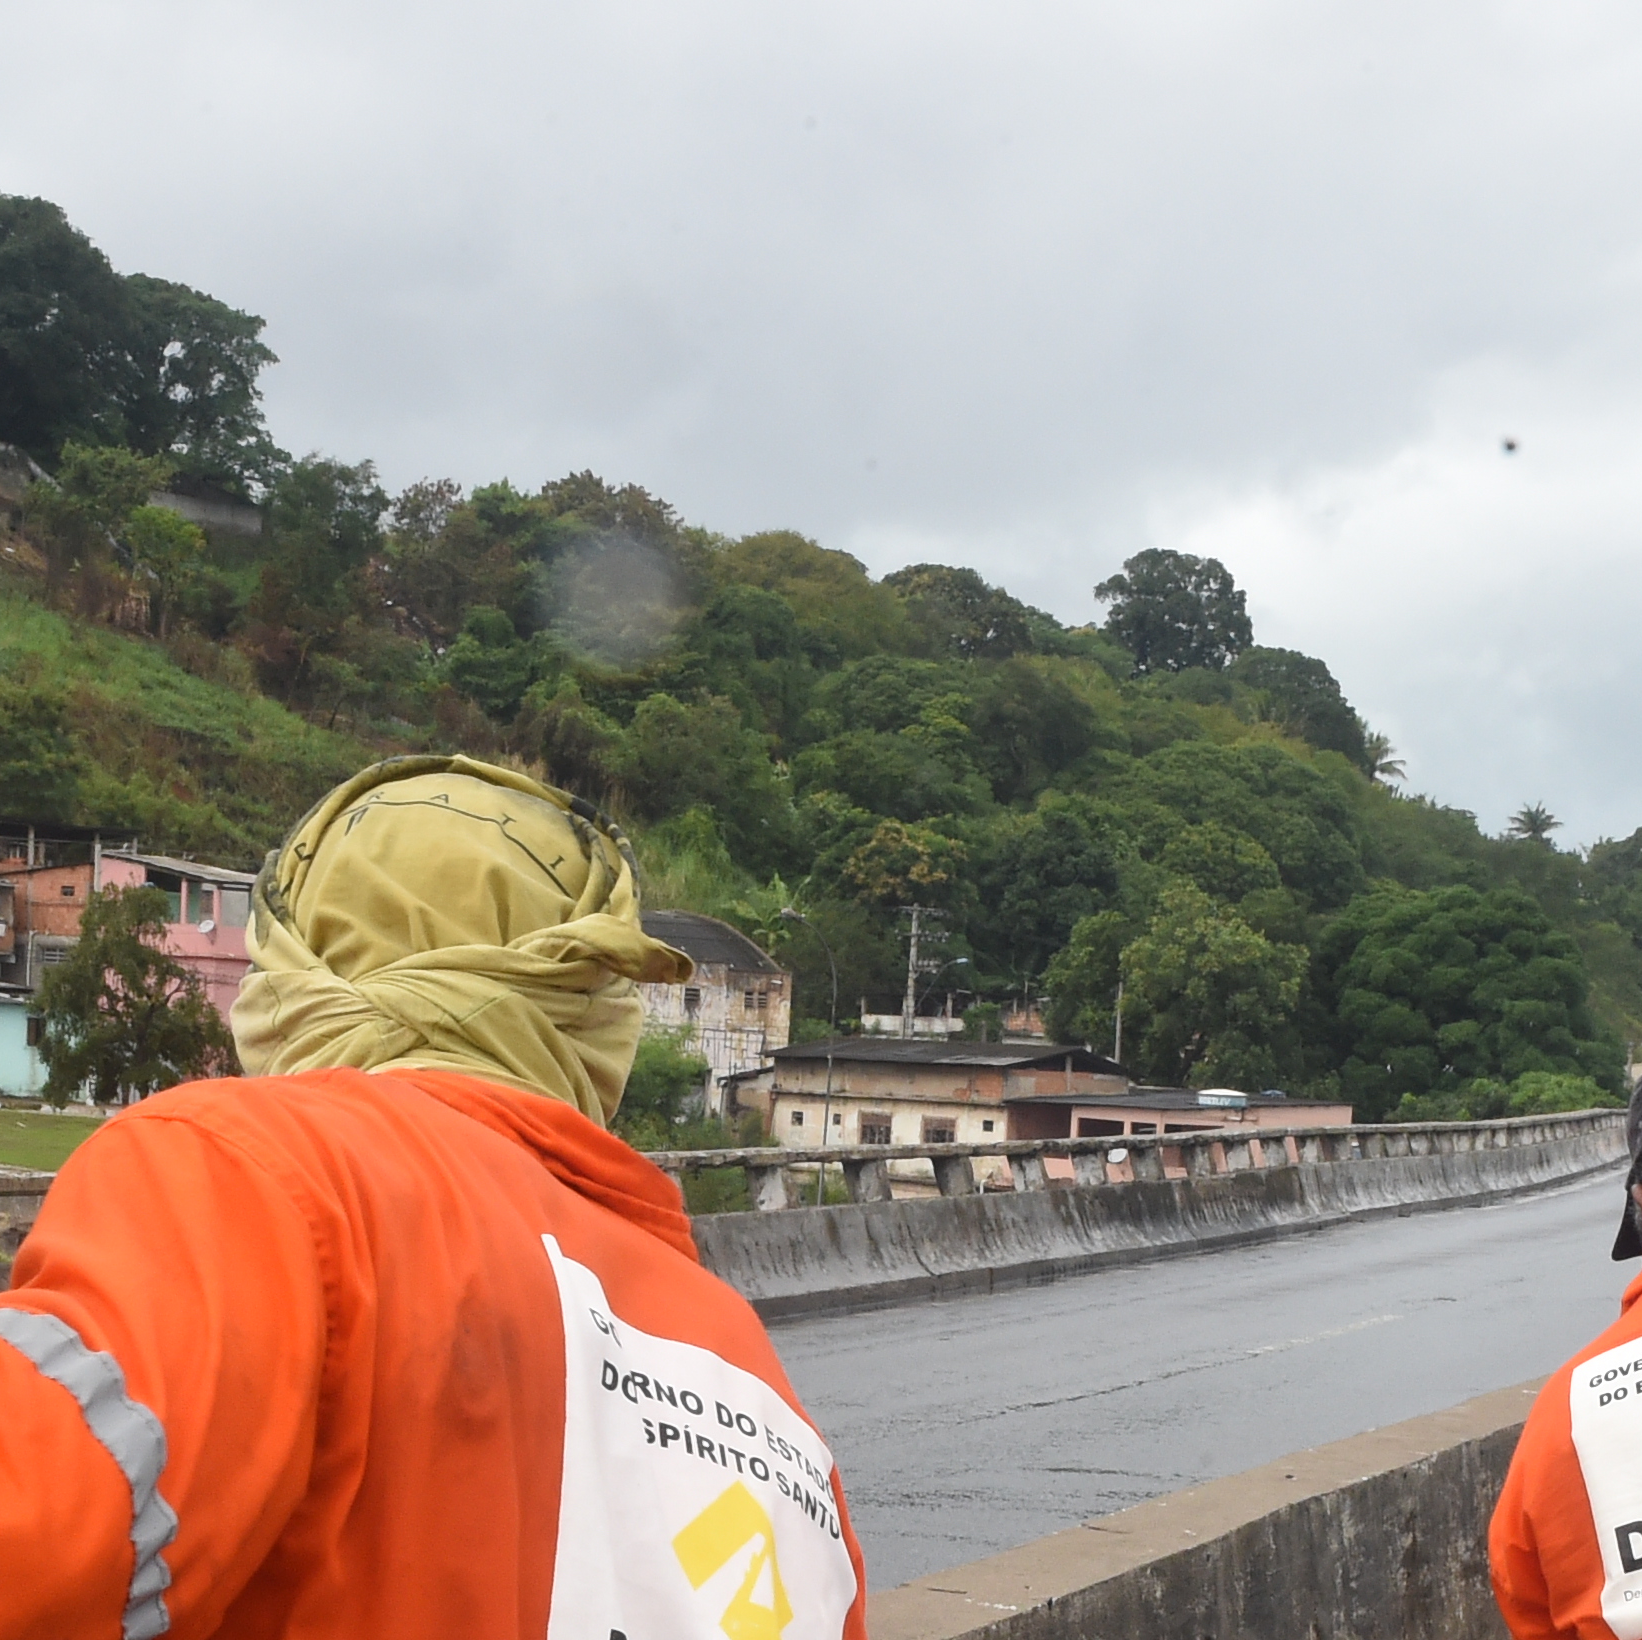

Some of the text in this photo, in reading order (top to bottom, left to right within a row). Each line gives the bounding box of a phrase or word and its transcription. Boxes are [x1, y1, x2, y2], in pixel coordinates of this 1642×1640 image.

[1599, 1387, 1628, 1407] DO
[715, 1400, 757, 1437] DO
[642, 1418, 840, 1540] SPÍRITO SANTO
